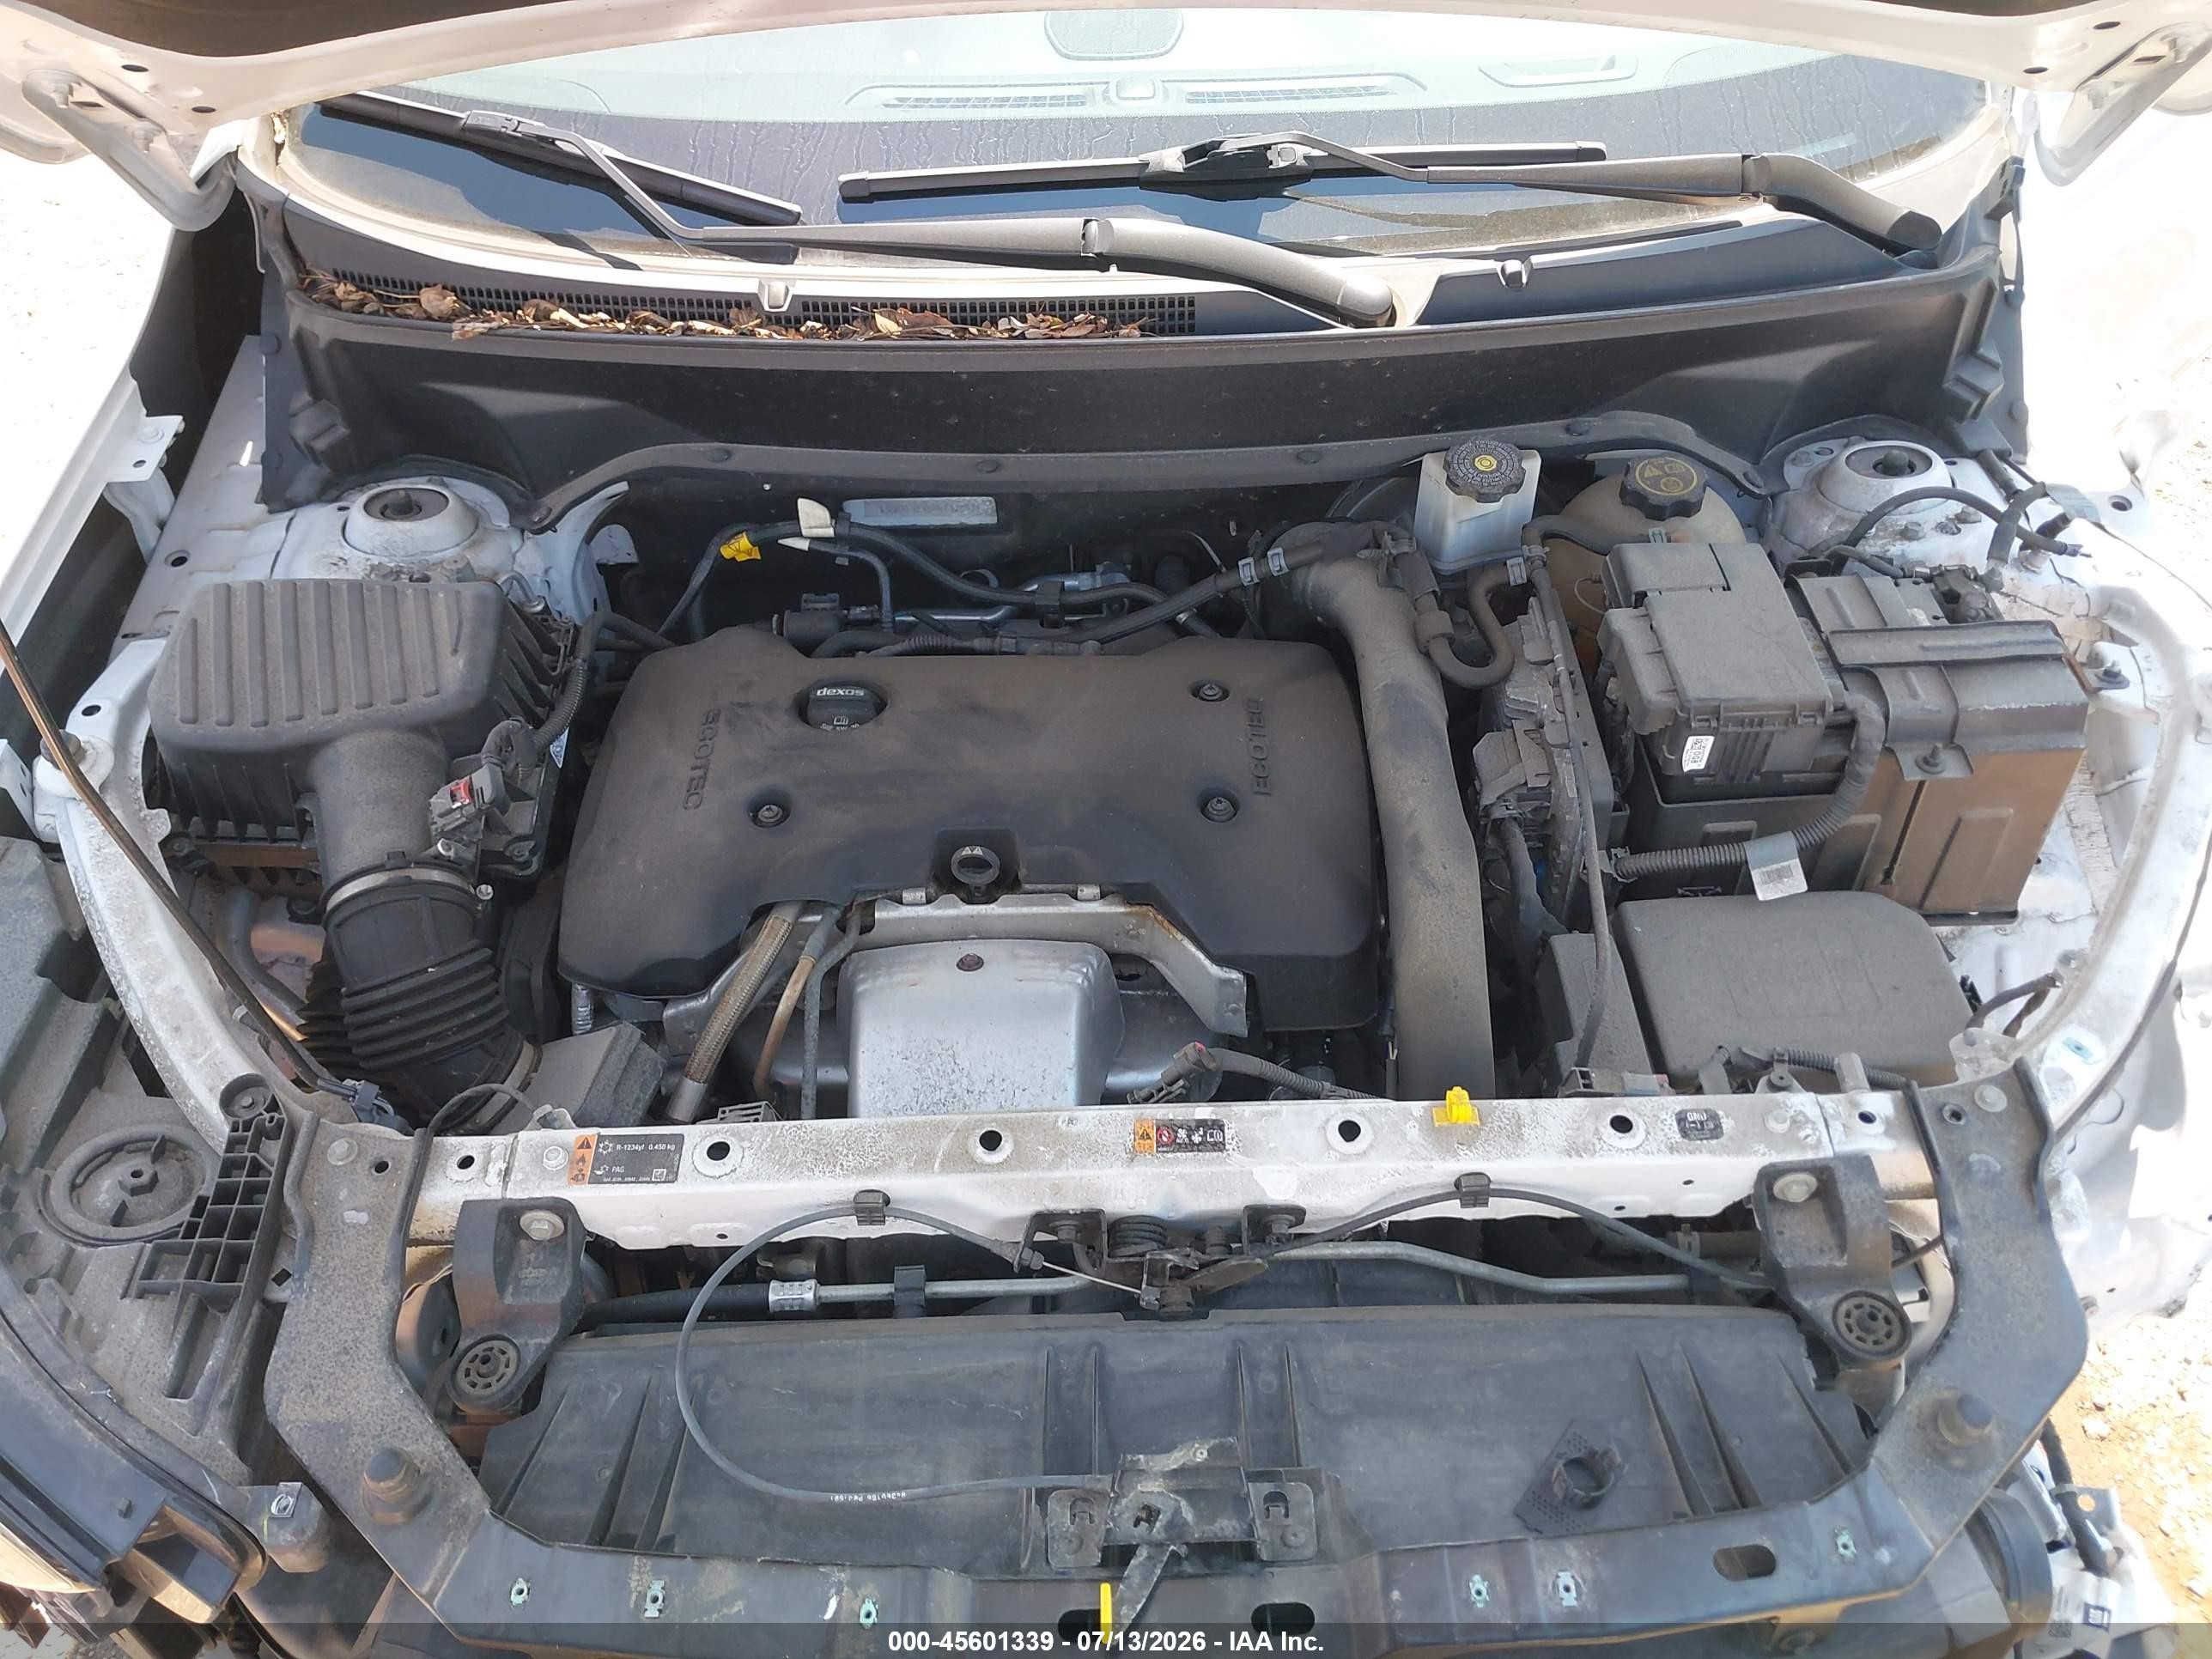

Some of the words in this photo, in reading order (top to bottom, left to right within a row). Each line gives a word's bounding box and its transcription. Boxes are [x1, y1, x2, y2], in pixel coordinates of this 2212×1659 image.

[817, 687, 865, 696] dexos
[683, 708, 721, 811] ECOTEC
[1243, 699, 1273, 796] ECOTEC
[616, 1143, 645, 1152] R-1234yf
[666, 1143, 676, 1152] kg
